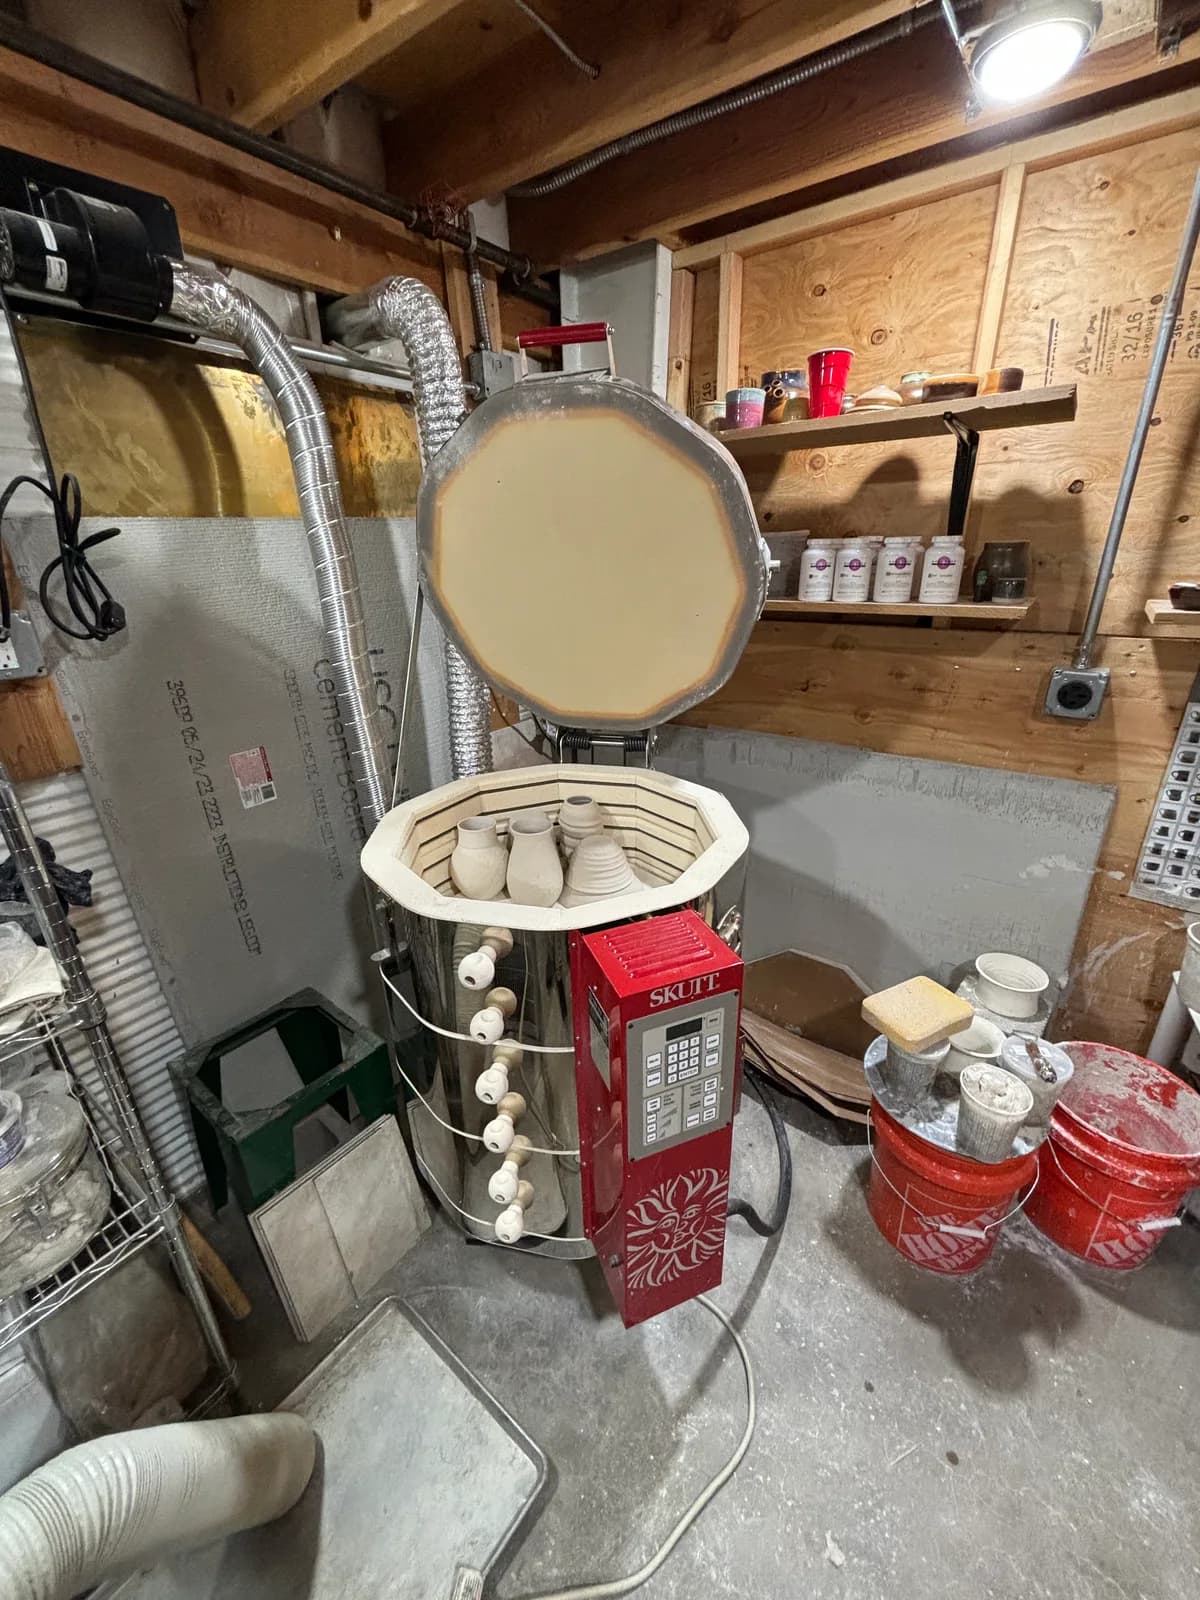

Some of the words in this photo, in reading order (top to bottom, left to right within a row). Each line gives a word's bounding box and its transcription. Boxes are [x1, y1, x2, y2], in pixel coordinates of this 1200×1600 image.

[1121, 312, 1144, 363] 32/16
[313, 658, 348, 766] Cement
[336, 771, 367, 842] Board
[649, 972, 720, 1008] SKUTT
